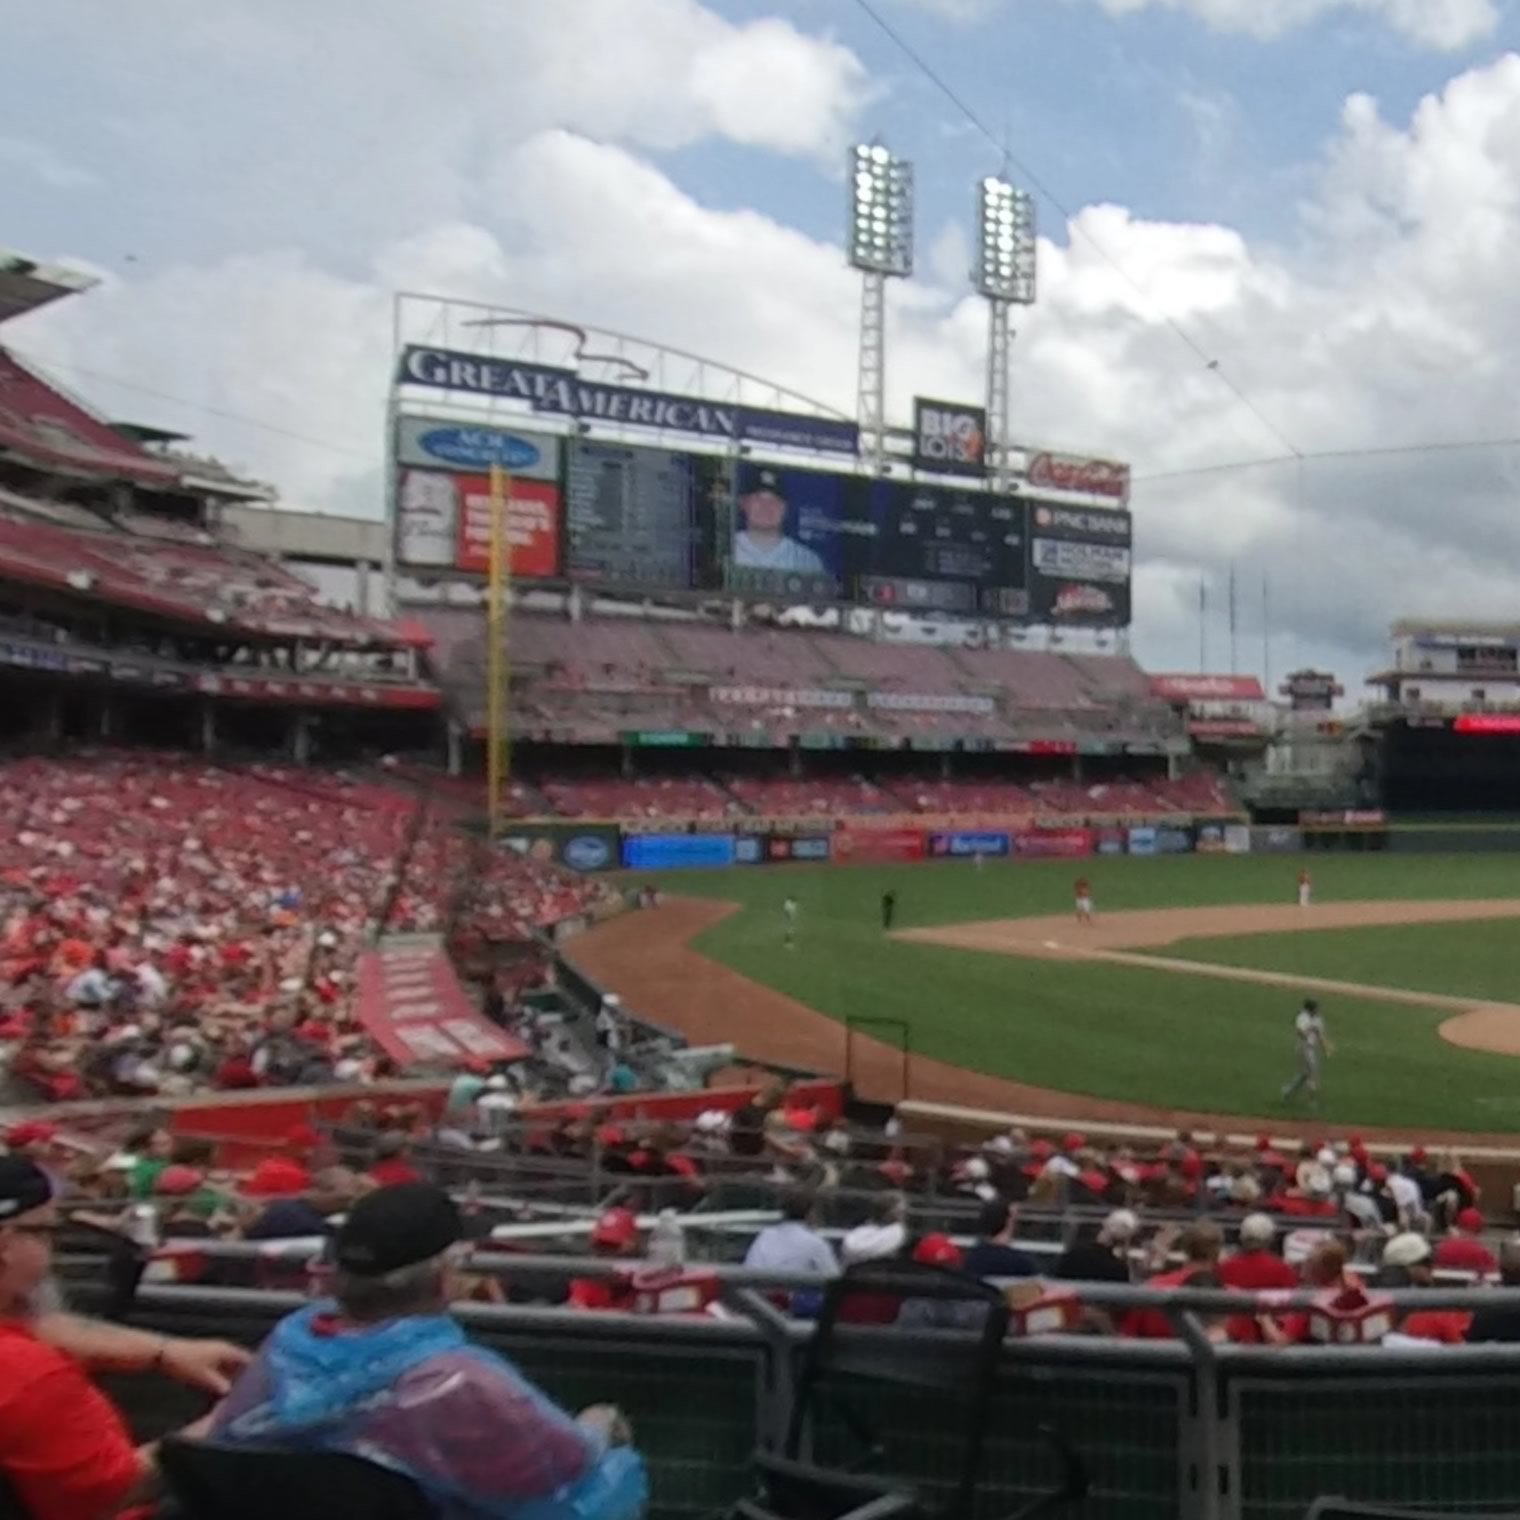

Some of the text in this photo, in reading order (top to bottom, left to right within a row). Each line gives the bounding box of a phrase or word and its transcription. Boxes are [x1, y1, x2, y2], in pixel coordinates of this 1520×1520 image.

[407, 348, 736, 435] GREAT AMERICAN
[920, 408, 975, 440] BIG
